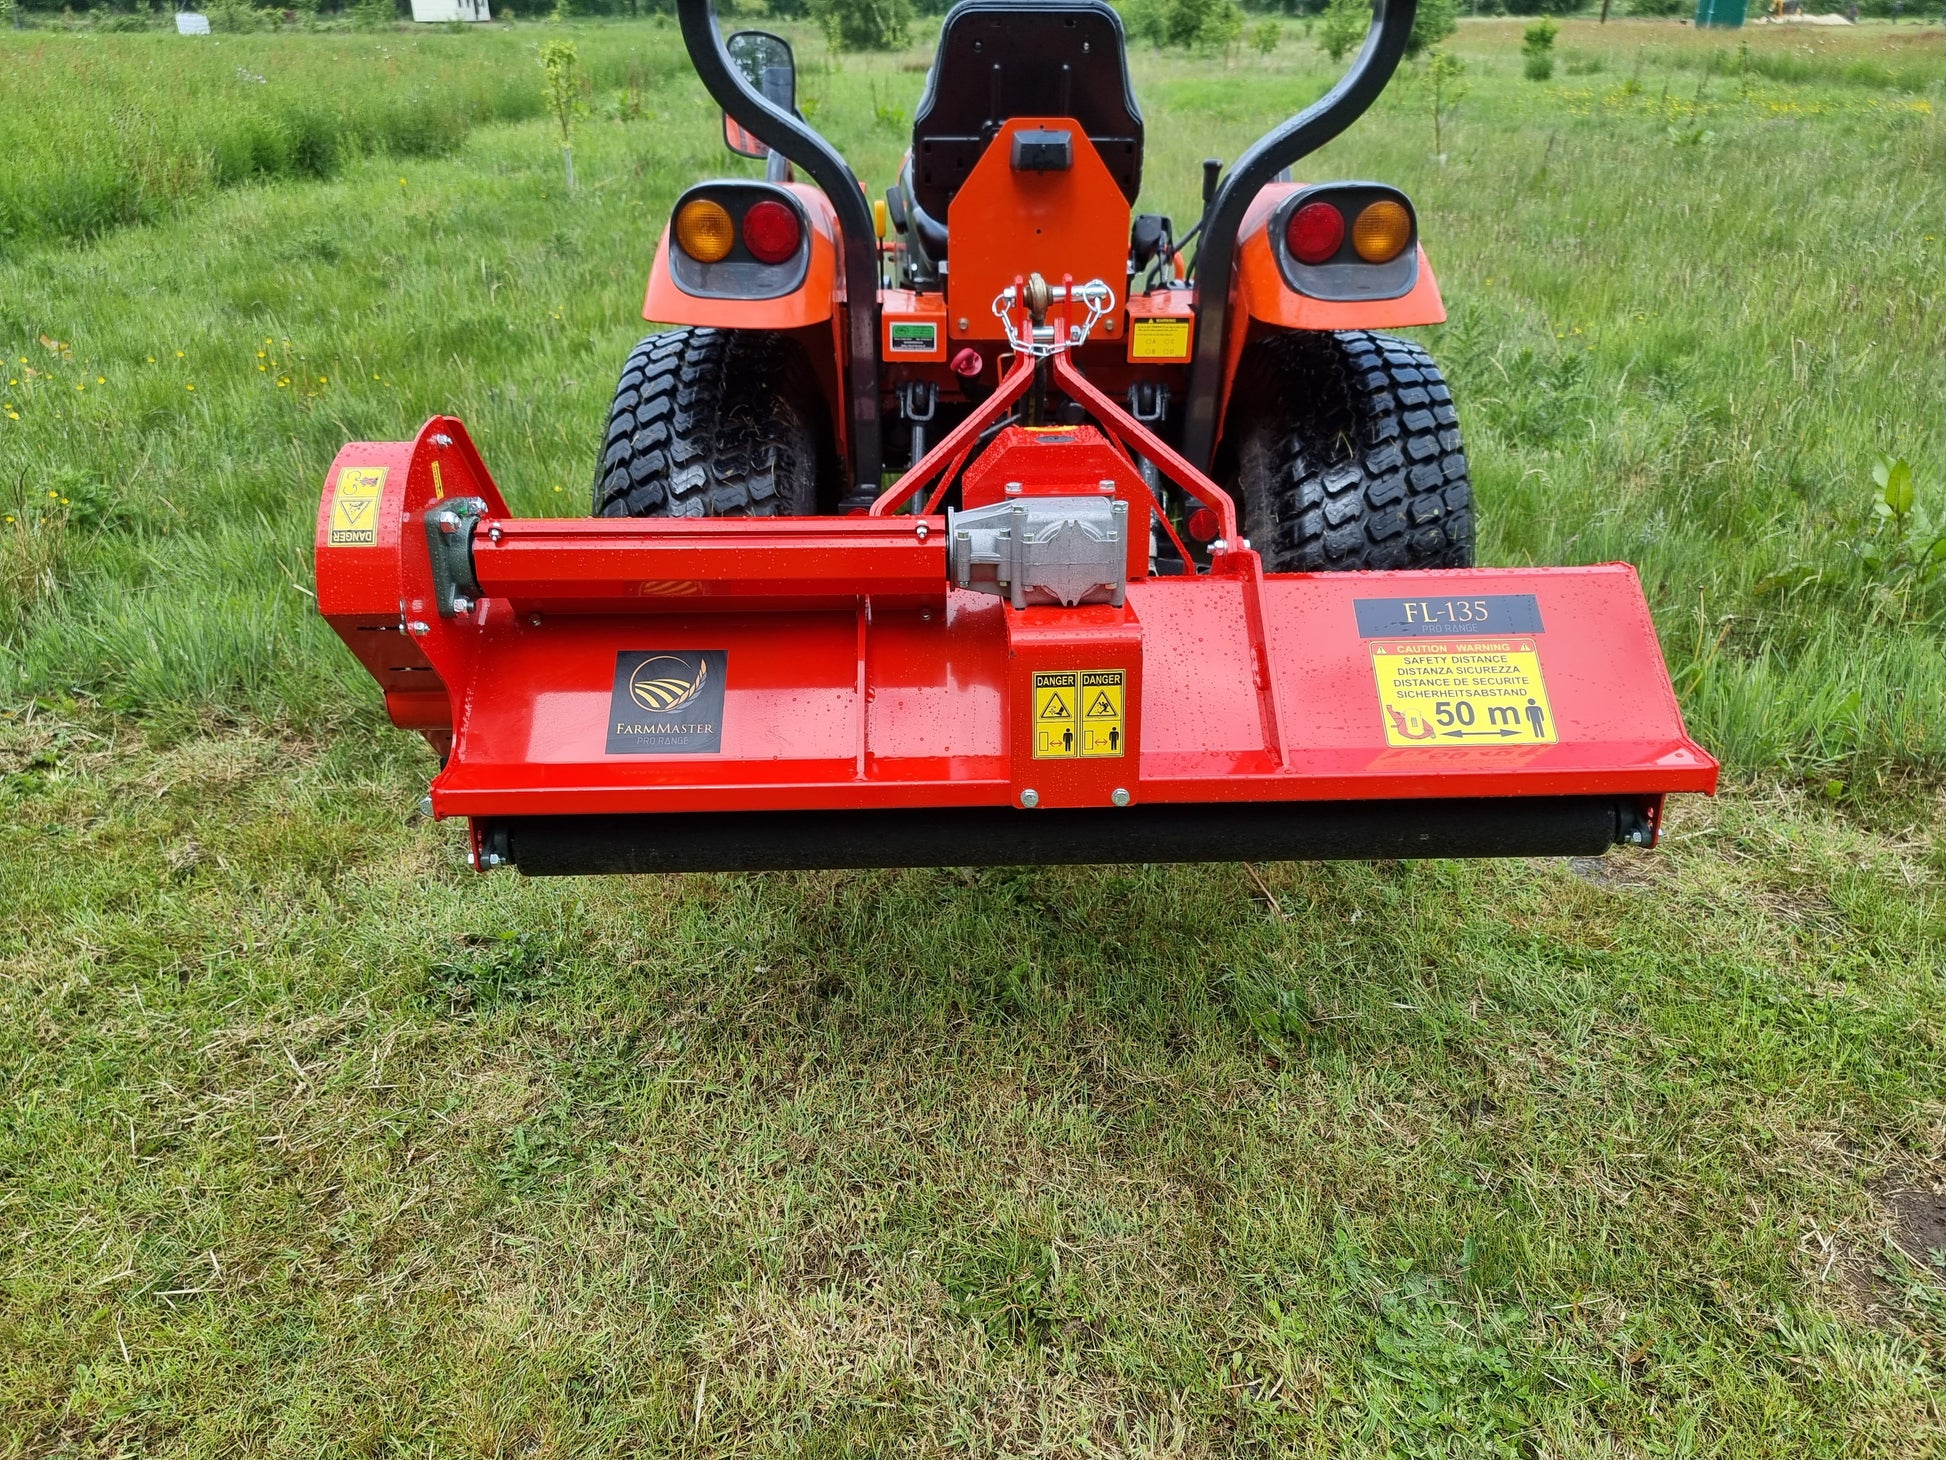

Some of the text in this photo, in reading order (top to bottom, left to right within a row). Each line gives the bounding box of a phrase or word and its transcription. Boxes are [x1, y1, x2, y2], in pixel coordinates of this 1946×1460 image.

[333, 530, 372, 542] DANGER
[1403, 600, 1489, 623] FL-135
[1422, 623, 1479, 633] PRO RANGE
[1397, 643, 1510, 654] CAUTION WARNING
[1404, 655, 1508, 664] SAFETY DISTANCE
[1398, 666, 1520, 676] DISTANZA SICUREZZA
[1037, 676, 1074, 686] DANGER
[1084, 674, 1121, 684] DANGER
[1394, 676, 1530, 687] DISTANCE DE SECURITE
[1396, 688, 1528, 698] SICHERHEITSABSTAND
[1435, 701, 1520, 726] 50 m
[637, 736, 689, 745] PRO RANGE
